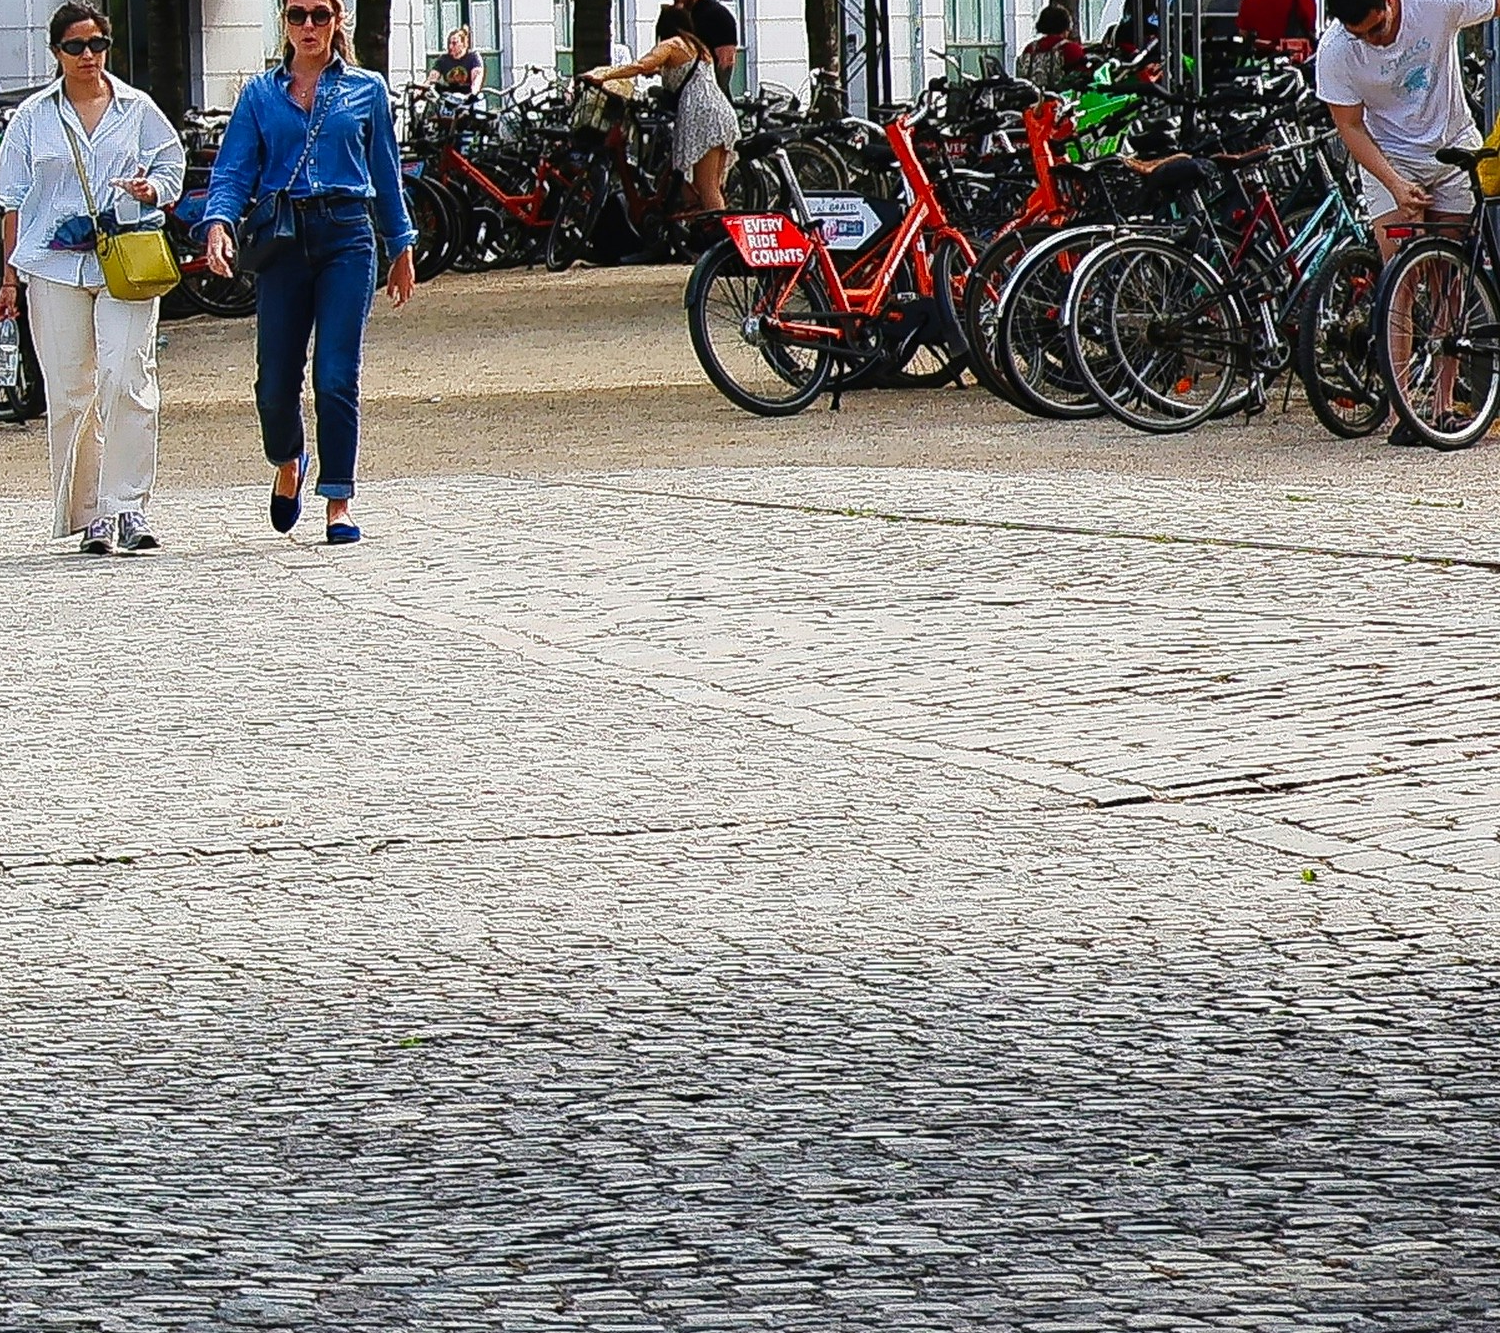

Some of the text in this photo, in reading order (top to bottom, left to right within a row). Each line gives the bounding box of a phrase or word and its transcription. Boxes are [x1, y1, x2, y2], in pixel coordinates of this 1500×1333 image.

[743, 217, 784, 234] EVERY
[747, 233, 779, 249] RIDE
[750, 247, 806, 265] COUNTS
